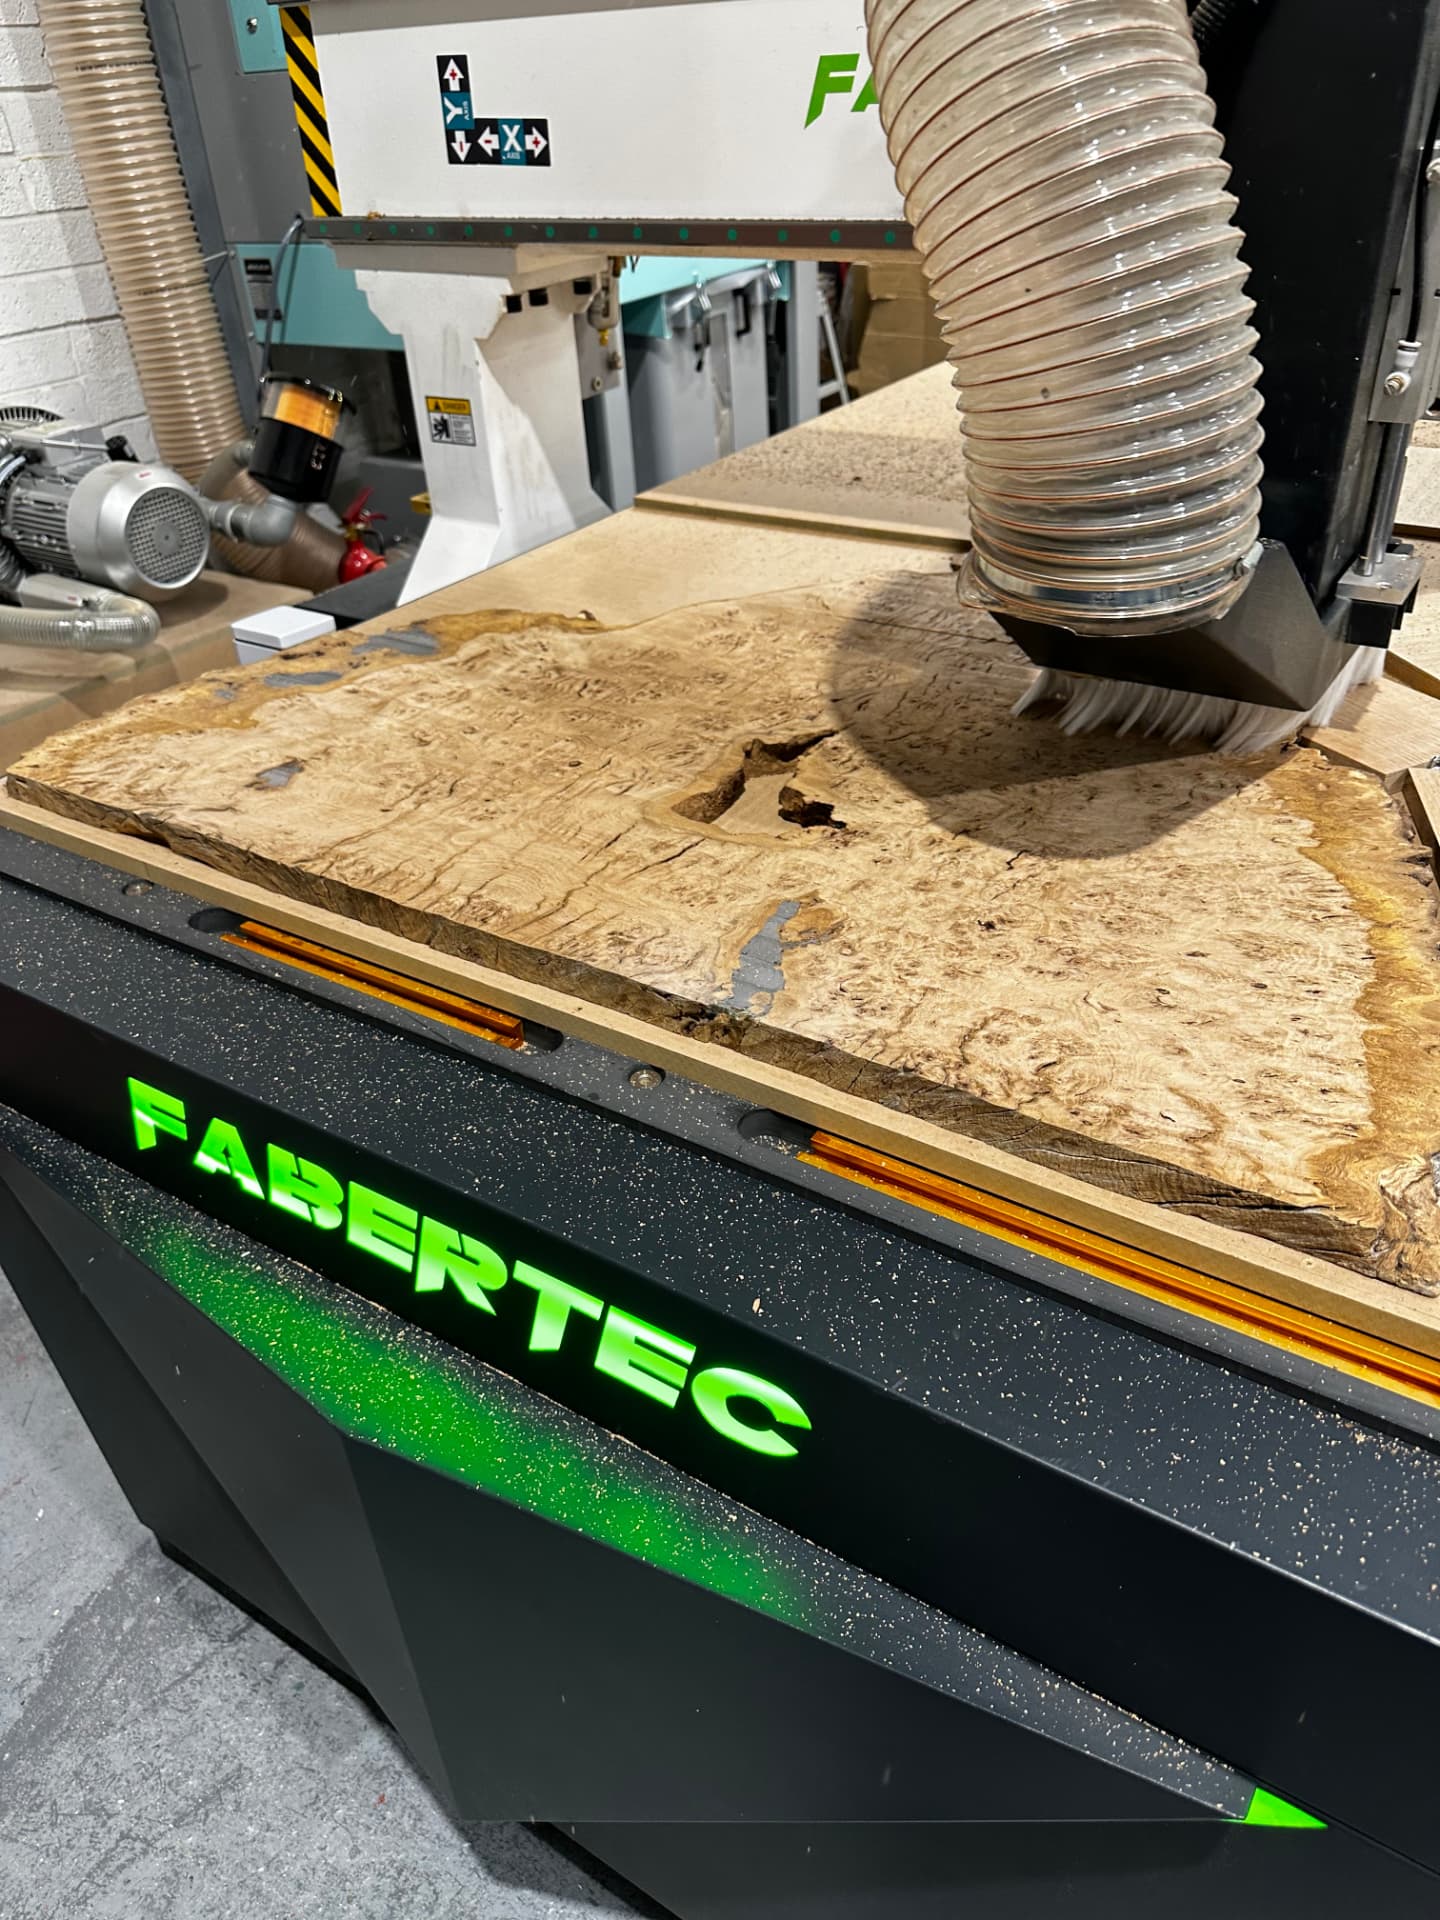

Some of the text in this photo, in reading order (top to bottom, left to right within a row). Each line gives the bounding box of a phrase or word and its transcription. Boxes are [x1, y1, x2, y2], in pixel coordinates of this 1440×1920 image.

[443, 96, 463, 126] Y
[502, 124, 522, 152] X
[506, 152, 521, 160] AXIS
[127, 1077, 812, 1457] FABERTEC
